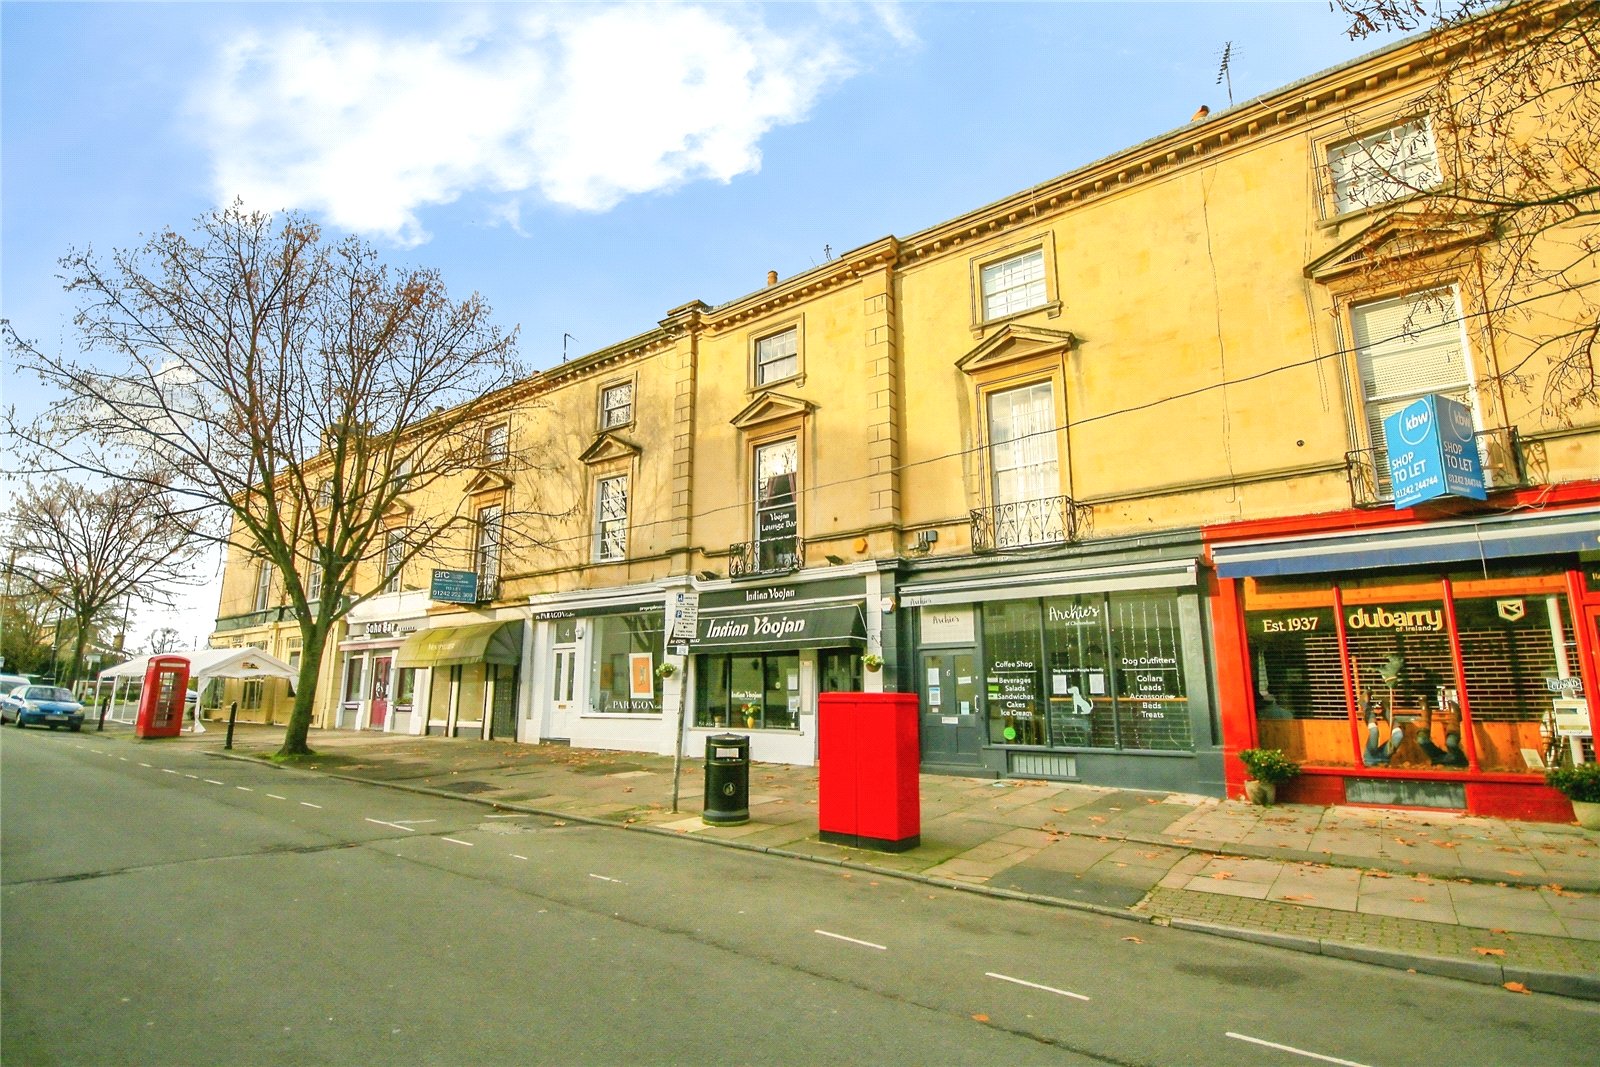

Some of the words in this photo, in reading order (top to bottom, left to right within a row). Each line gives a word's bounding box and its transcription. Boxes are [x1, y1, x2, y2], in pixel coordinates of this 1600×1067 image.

[1406, 411, 1428, 431] kbw
[1444, 441, 1462, 454] SHOP
[1392, 452, 1414, 470] SHOP
[1445, 454, 1457, 469] TO
[1459, 459, 1473, 472] LET
[1393, 470, 1407, 484] TO
[1409, 460, 1426, 479] LET
[762, 523, 784, 531] Lounge
[434, 570, 450, 579] arc
[746, 590, 768, 602] Indian
[768, 587, 795, 601] Voojan
[1049, 604, 1100, 622] Archie's
[1348, 607, 1443, 631] dubarry
[706, 618, 750, 639] Indian
[753, 616, 806, 639] Voojan
[1287, 616, 1319, 632] 1937
[565, 628, 570, 638] 4
[1016, 660, 1033, 668] Shop
[1122, 657, 1138, 667] Dog
[1139, 656, 1176, 665] Outfitters
[1136, 674, 1163, 682] Collars
[1139, 683, 1162, 691] Leads
[612, 700, 654, 709] PARAGON
[1011, 709, 1033, 717] Cream
